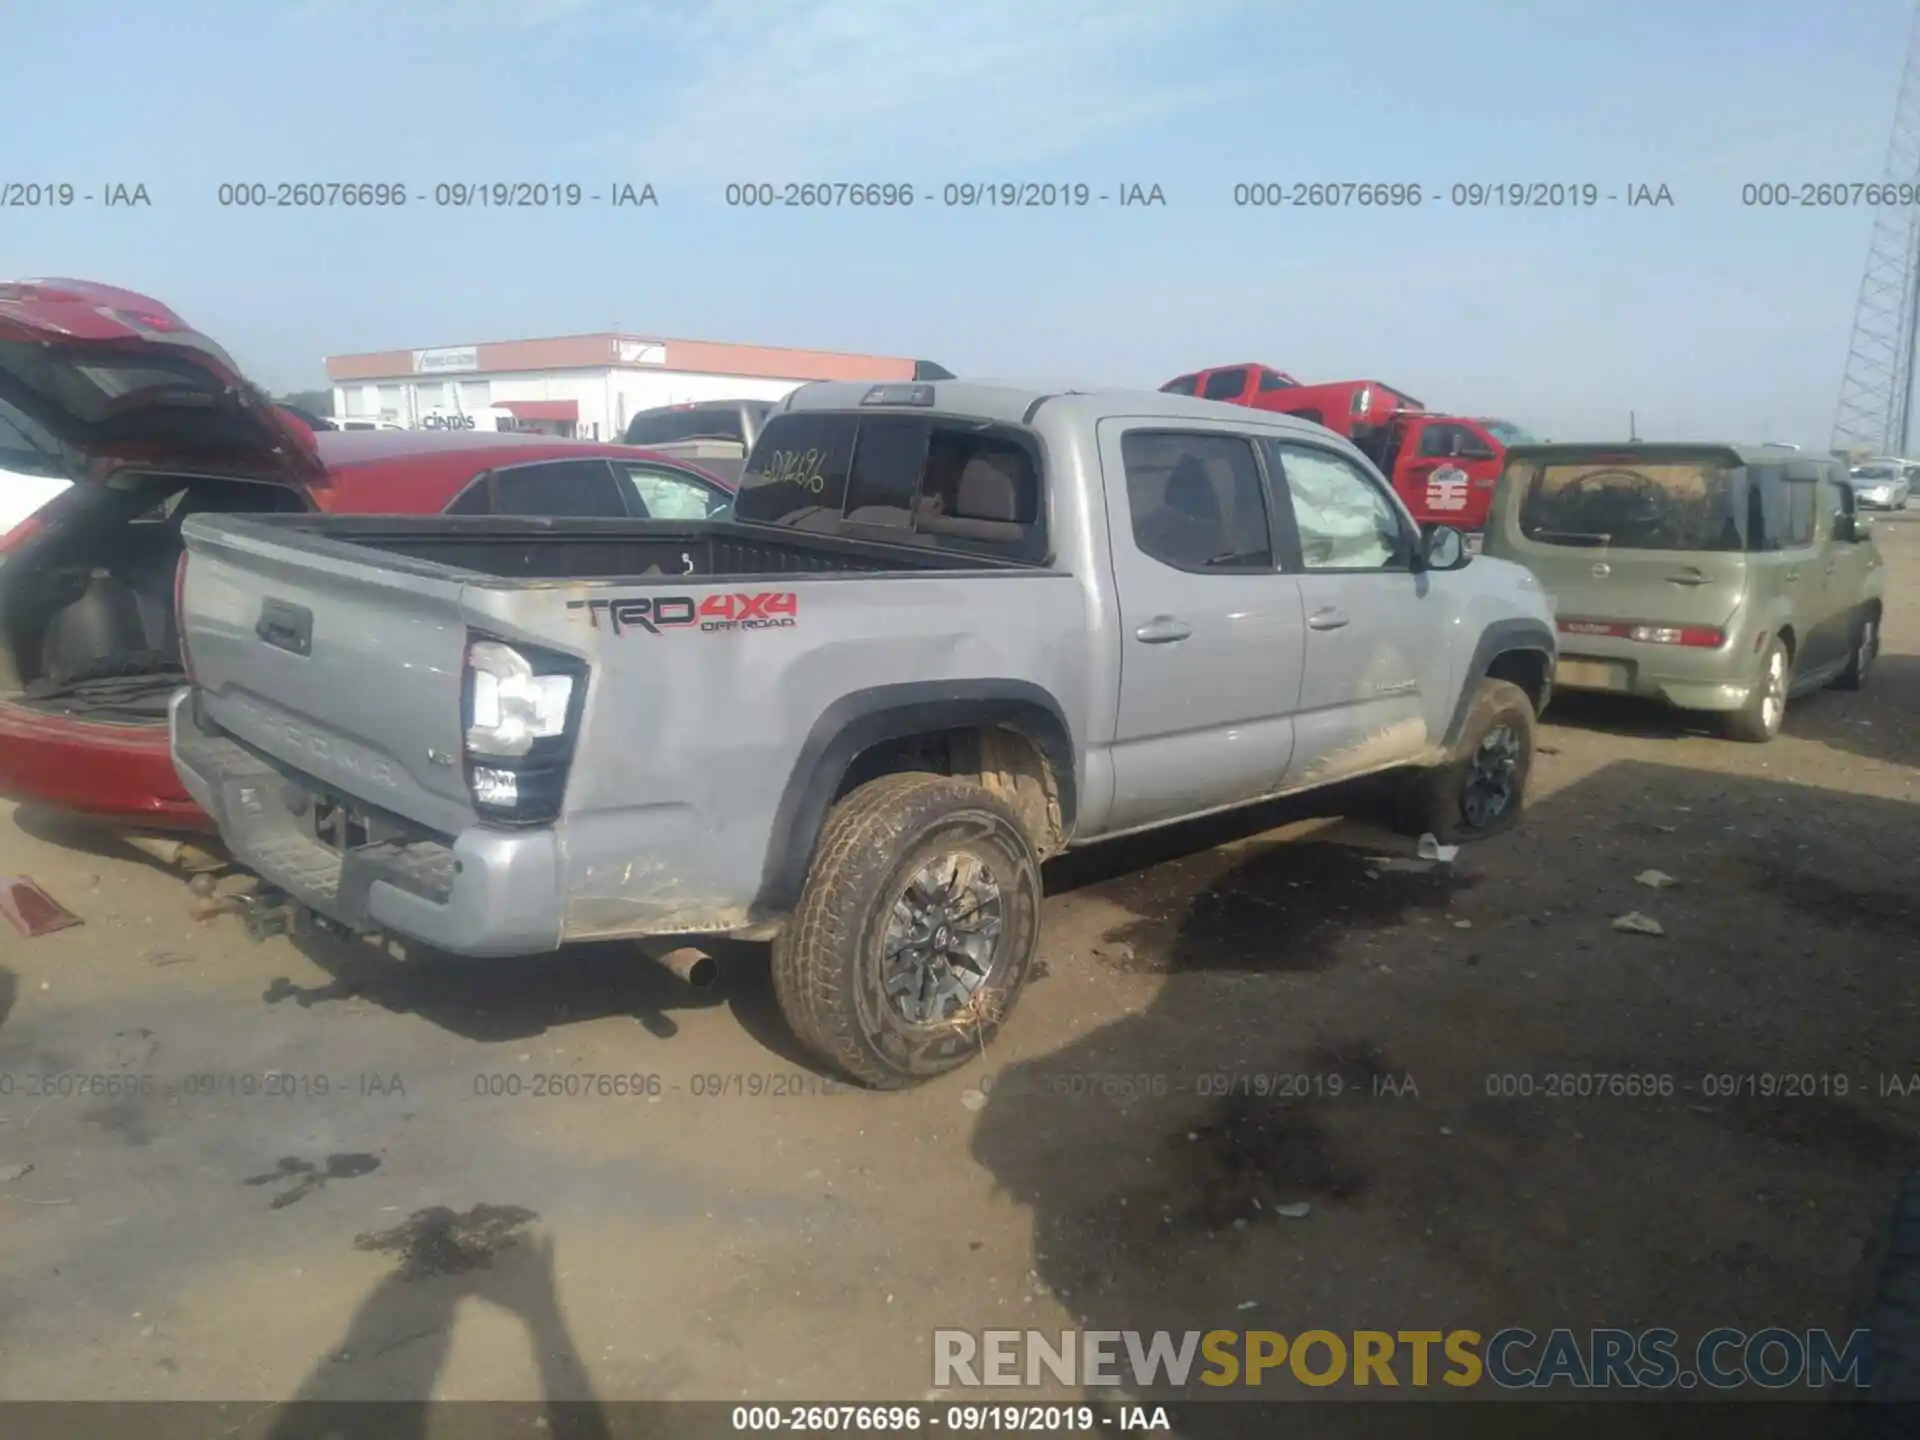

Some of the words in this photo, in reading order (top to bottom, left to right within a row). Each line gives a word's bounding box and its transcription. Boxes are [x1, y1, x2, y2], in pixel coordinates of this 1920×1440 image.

[566, 596, 698, 637] TRD
[700, 619, 738, 632] OFF
[741, 616, 796, 631] ROAD
